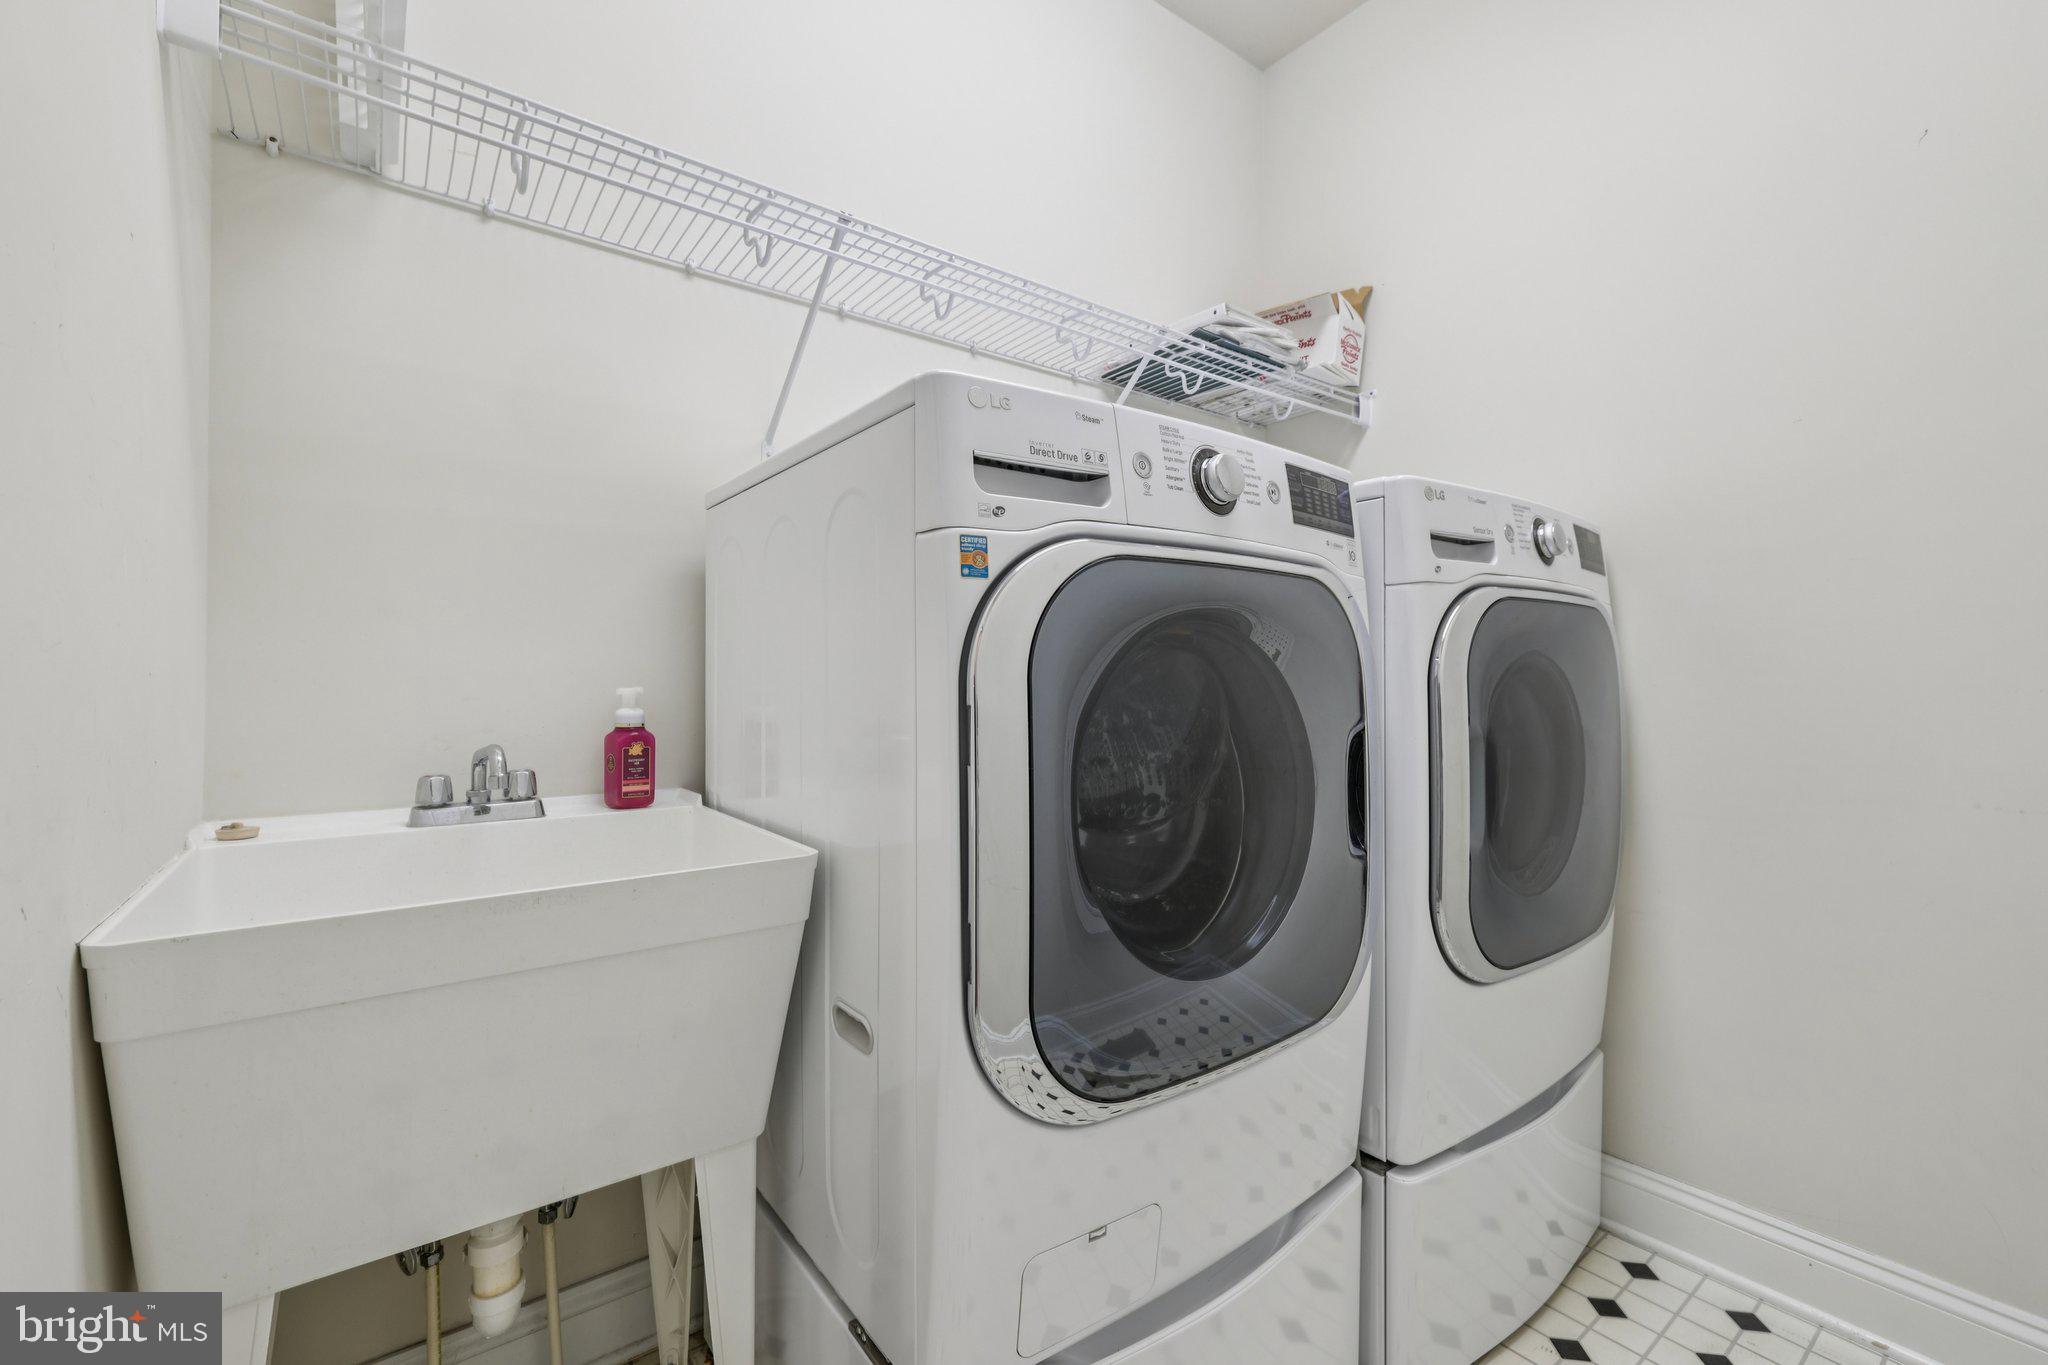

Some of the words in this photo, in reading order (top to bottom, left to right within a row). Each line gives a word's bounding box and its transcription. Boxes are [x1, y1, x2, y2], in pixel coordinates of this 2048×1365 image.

[1081, 414, 1101, 424] Steam
[1029, 445, 1056, 459] Direct
[1057, 450, 1079, 462] Drive
[1434, 489, 1446, 501] LG
